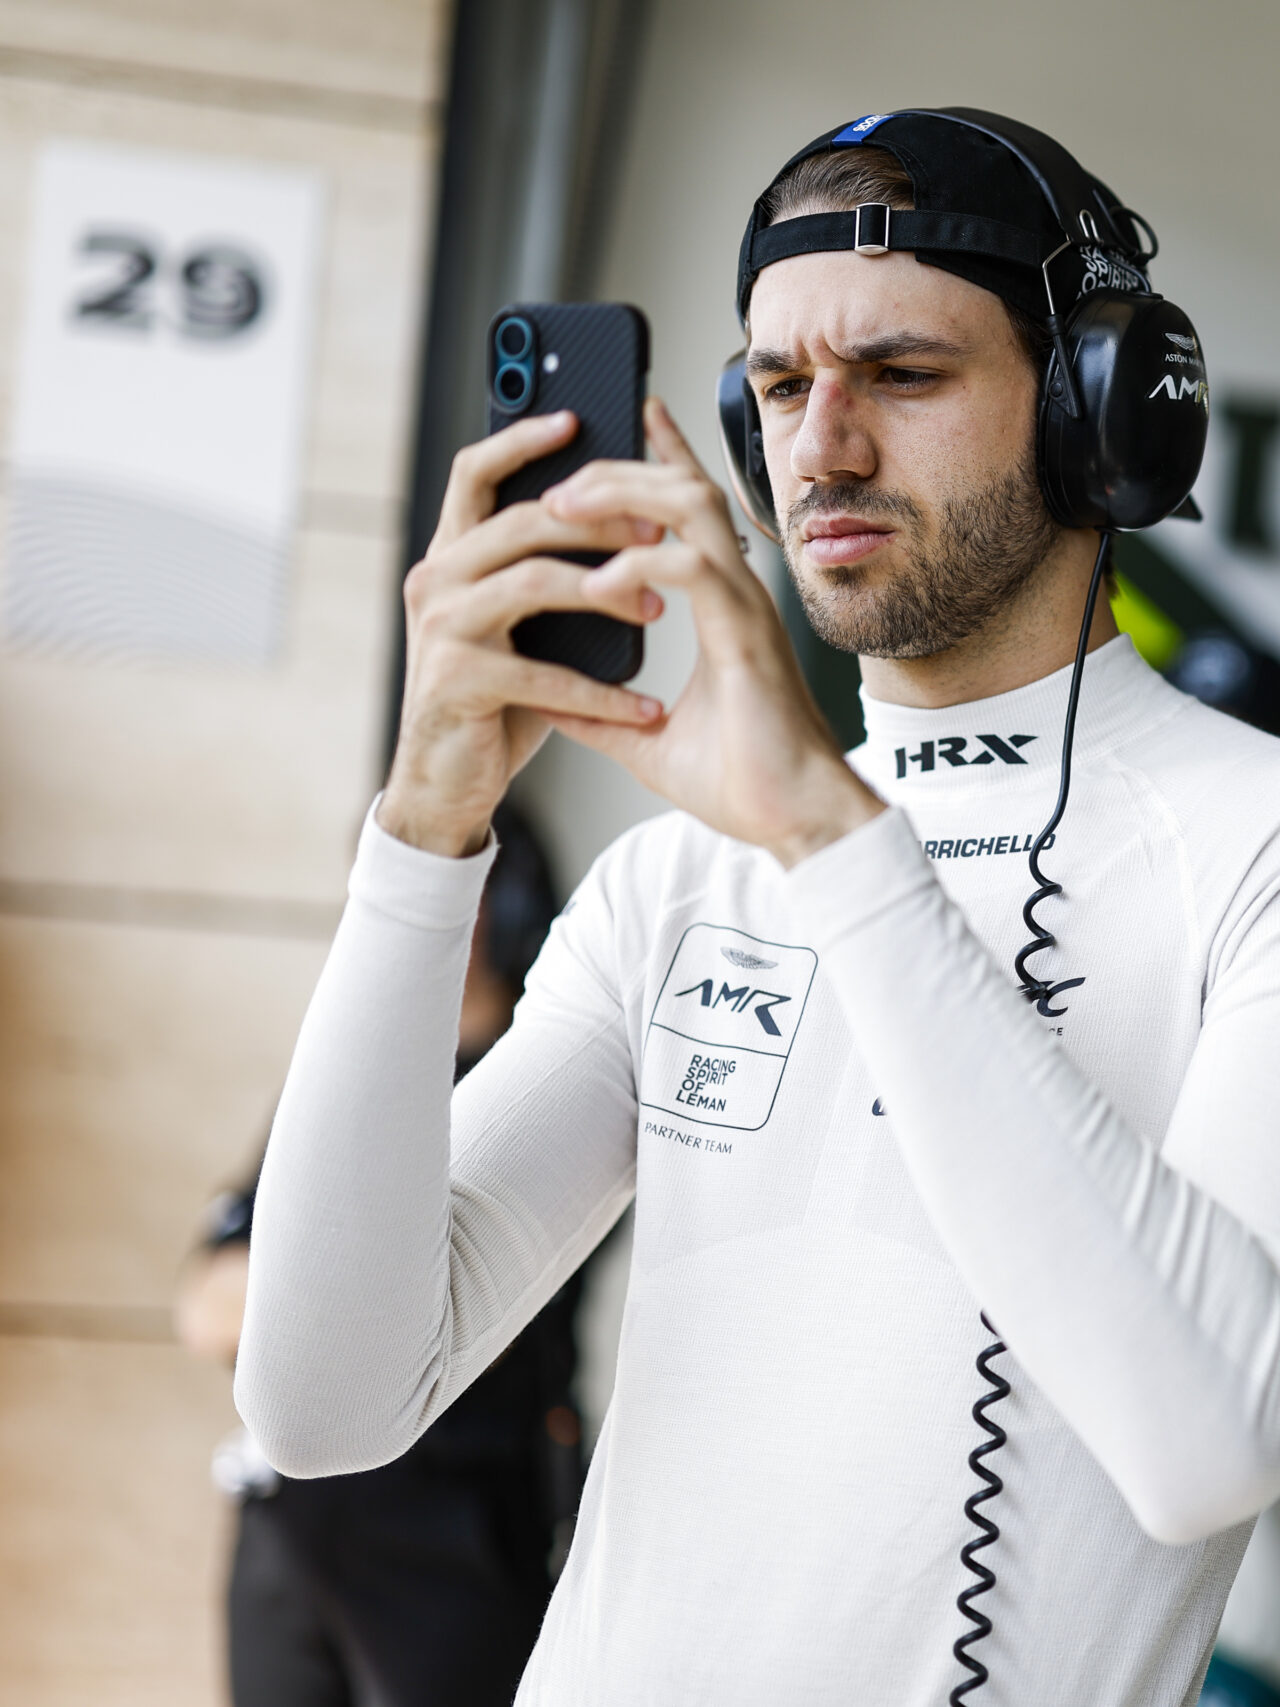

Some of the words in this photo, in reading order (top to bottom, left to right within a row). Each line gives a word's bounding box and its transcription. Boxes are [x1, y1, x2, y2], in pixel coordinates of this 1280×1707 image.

[68, 222, 270, 344] 29
[1165, 354, 1188, 363] ASTON
[895, 734, 1039, 779] HRX
[921, 833, 1056, 859] RRICHELLO
[674, 979, 792, 1037] AMR
[685, 1066, 728, 1086] SPIRIT
[690, 1054, 737, 1074] RACING
[681, 1079, 706, 1094] OF
[675, 1089, 727, 1112] LEMAN
[644, 1122, 702, 1149] PARTNER
[703, 1139, 733, 1154] TEAM
